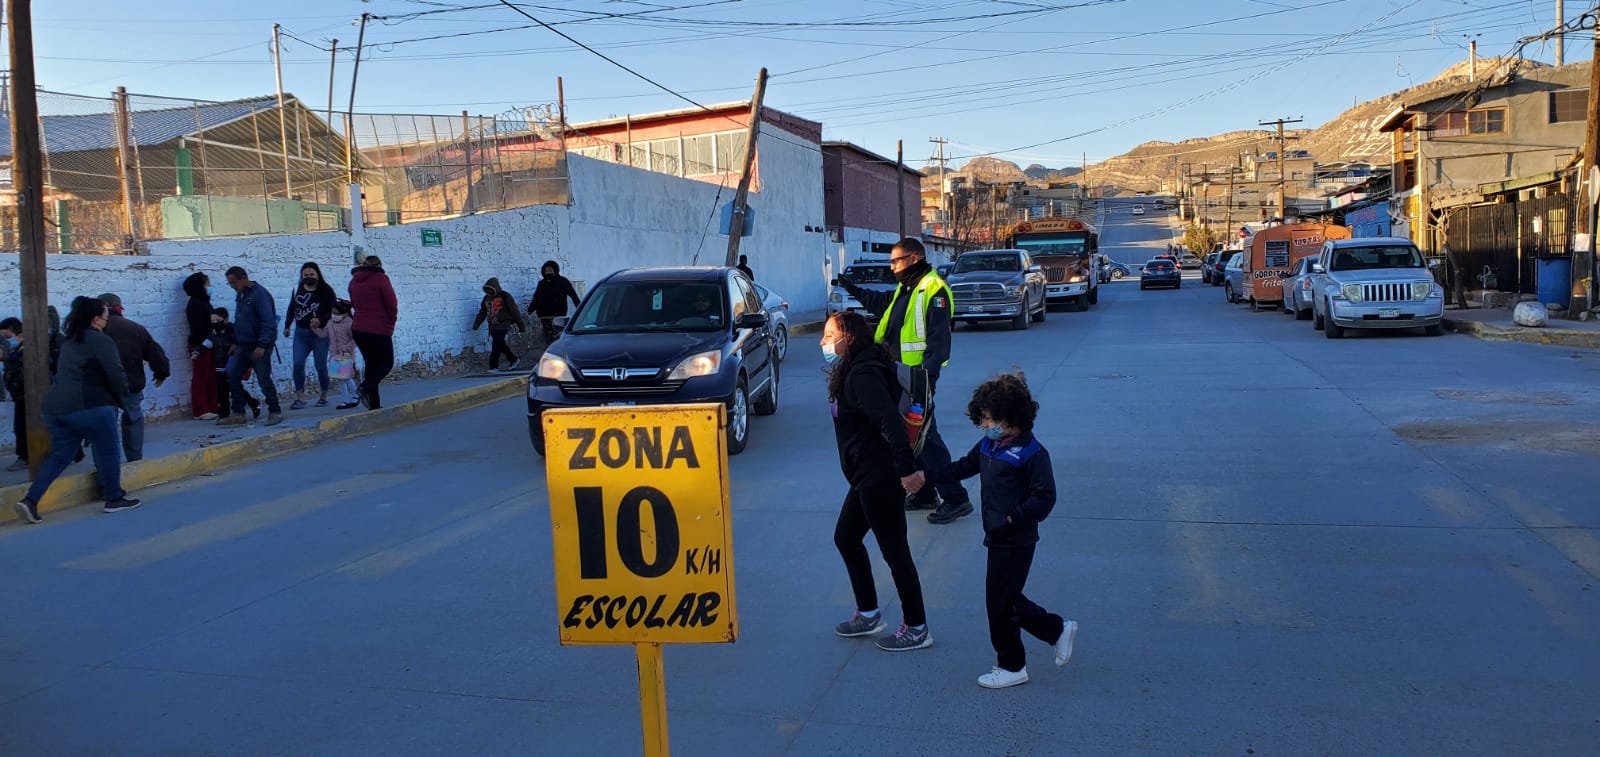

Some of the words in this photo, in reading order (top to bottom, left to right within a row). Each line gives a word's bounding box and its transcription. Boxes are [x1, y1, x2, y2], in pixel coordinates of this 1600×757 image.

[1293, 235, 1321, 246] TORTAS
[567, 425, 701, 470] ZONA
[573, 485, 680, 580] 10
[685, 544, 720, 576] K/H
[563, 591, 721, 630] ESCOLAR
